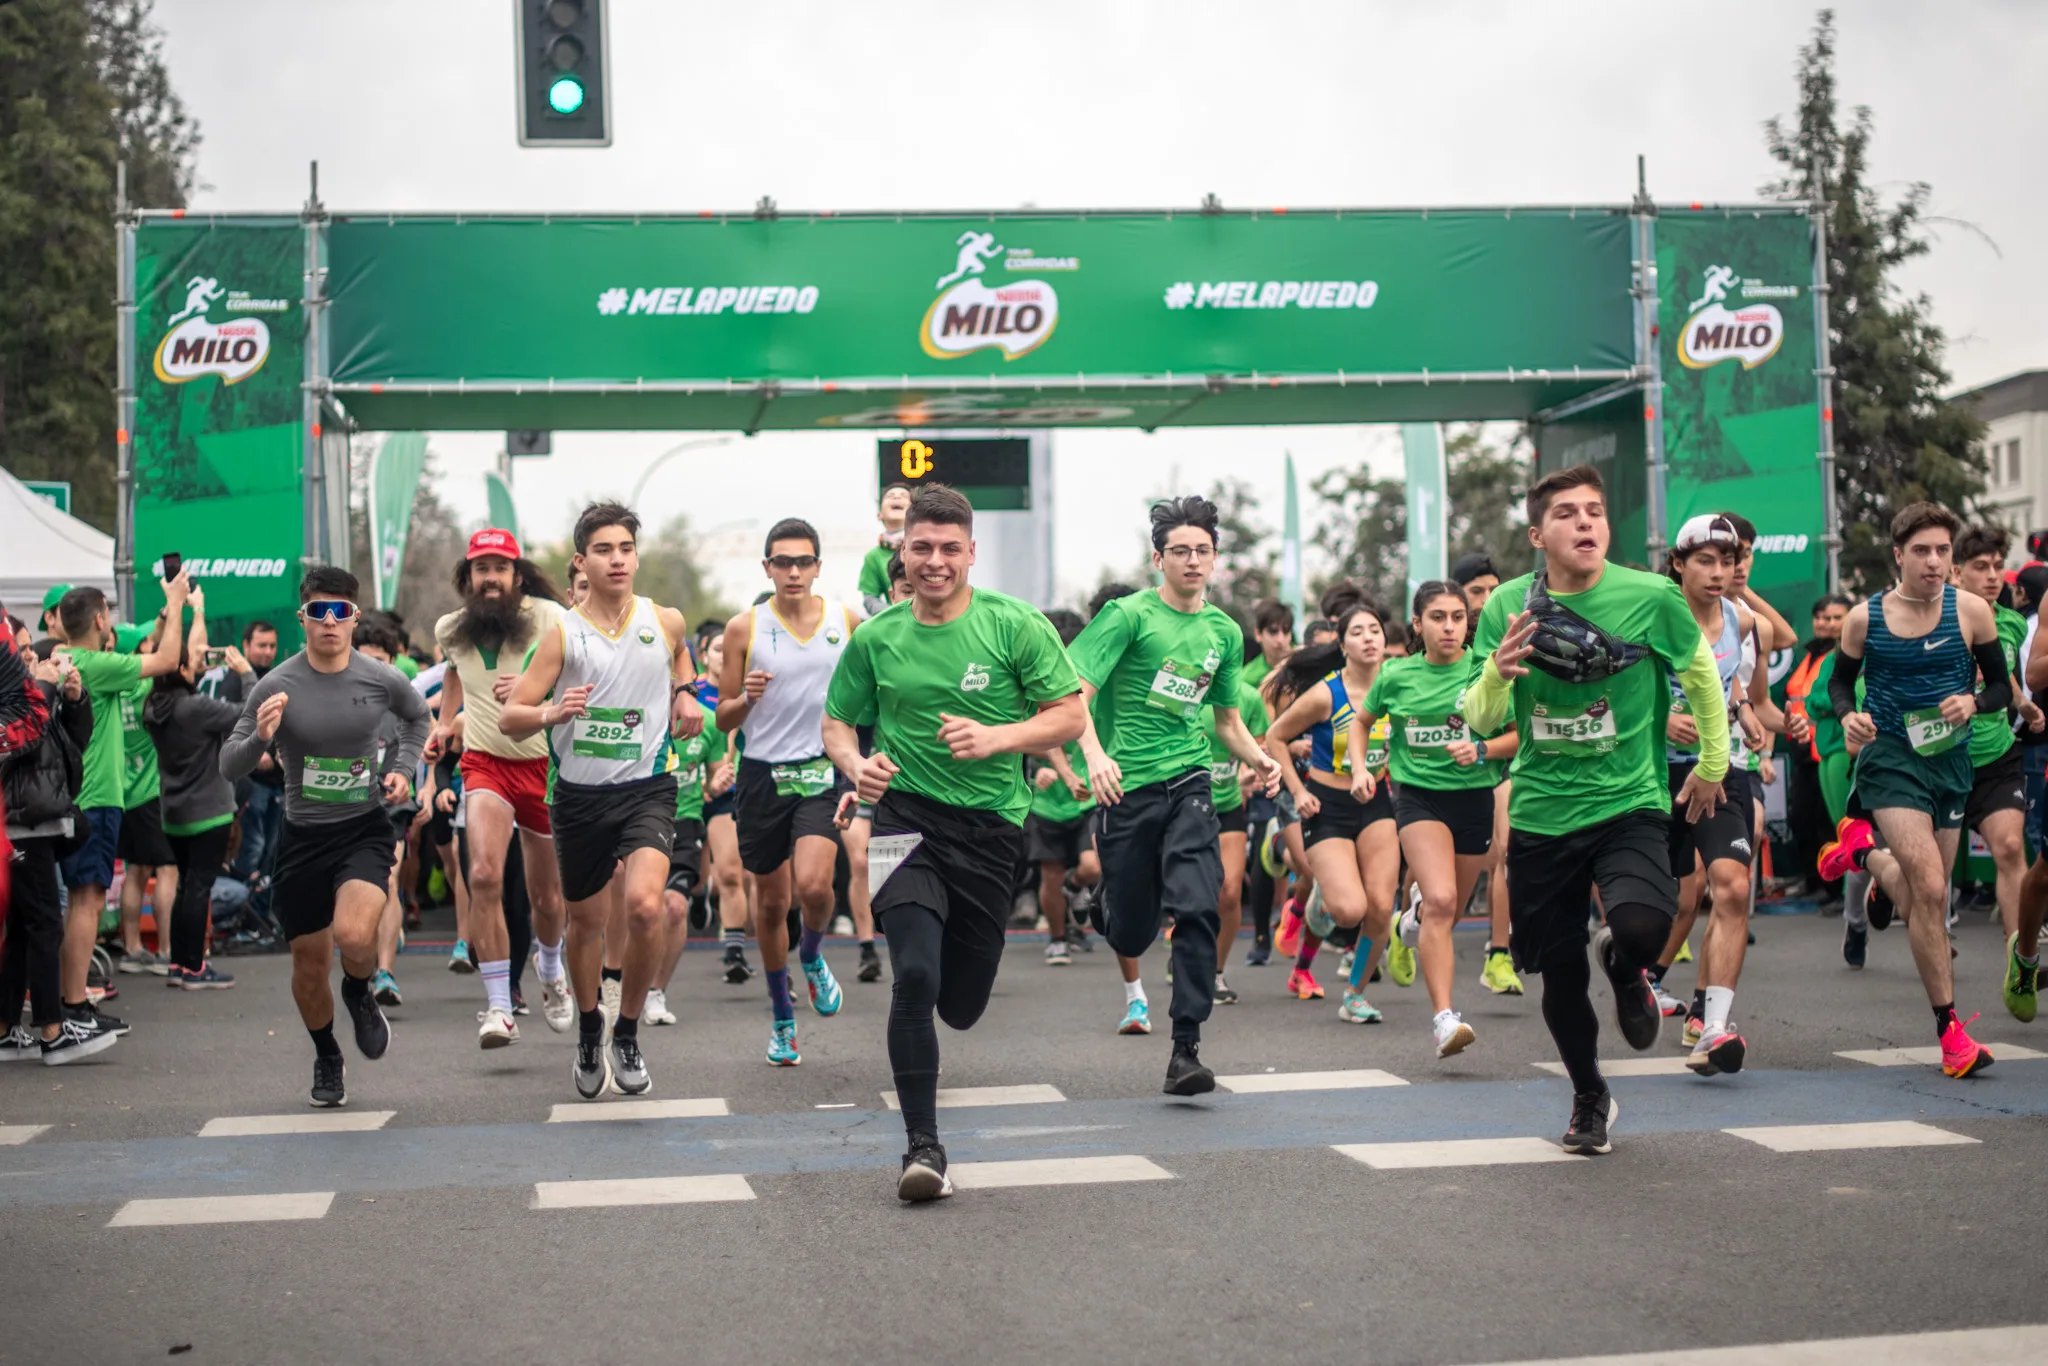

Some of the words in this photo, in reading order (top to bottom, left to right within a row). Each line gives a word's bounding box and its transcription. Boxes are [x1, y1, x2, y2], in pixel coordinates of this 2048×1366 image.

[596, 286, 819, 315] #MELAPUEDO
[1164, 280, 1379, 309] #MELAPUEDO
[941, 304, 1044, 337] MILO
[1693, 323, 1772, 350] MILO
[171, 338, 258, 365] MILO
[965, 678, 987, 686] MILO
[585, 725, 633, 741] 2892
[1414, 729, 1464, 743] 12035
[1544, 718, 1603, 738] 11536
[315, 774, 360, 787] 2977
